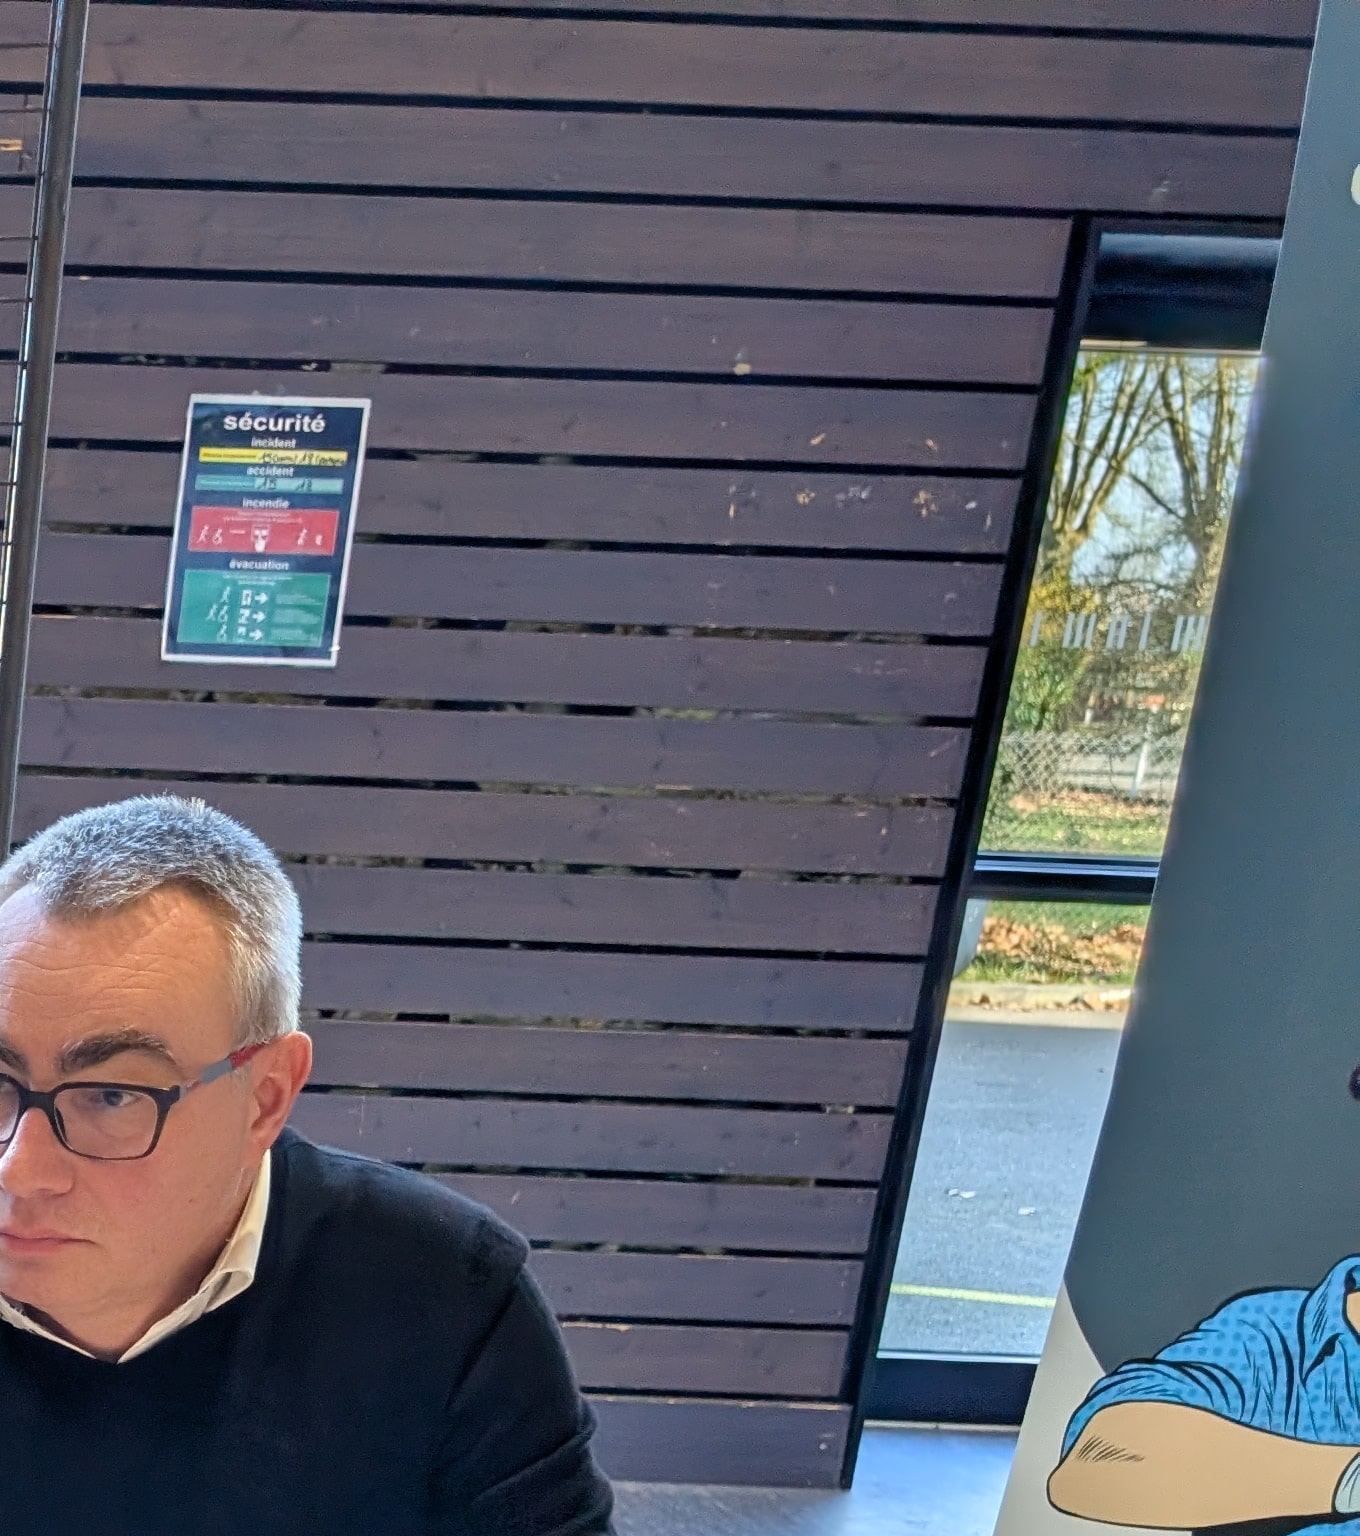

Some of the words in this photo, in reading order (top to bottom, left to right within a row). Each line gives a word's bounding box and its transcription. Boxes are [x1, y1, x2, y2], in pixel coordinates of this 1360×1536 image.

[223, 412, 326, 433] sécurité
[246, 466, 294, 477] accident
[242, 498, 290, 508] incendie
[229, 558, 290, 571] évacuation
